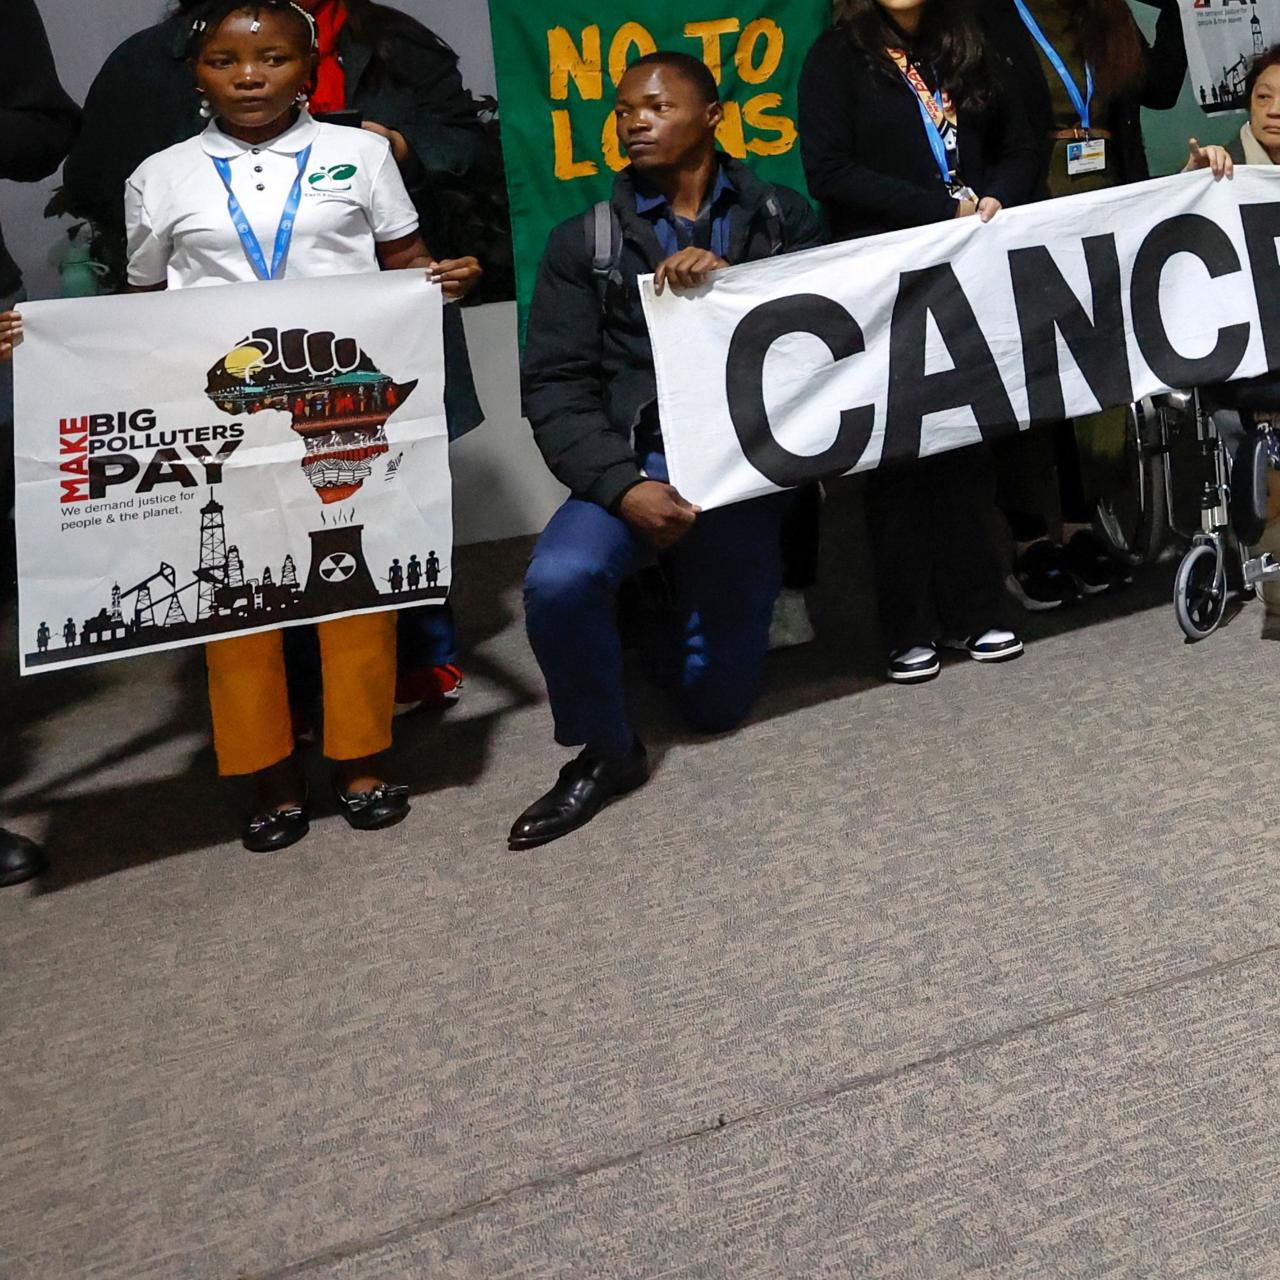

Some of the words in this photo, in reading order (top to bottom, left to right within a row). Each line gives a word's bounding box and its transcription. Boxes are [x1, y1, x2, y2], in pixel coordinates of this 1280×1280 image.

[683, 17, 784, 87] TO
[89, 409, 156, 436] BIG
[89, 423, 244, 454] POLLUTERS
[60, 416, 88, 503] MAKE
[88, 439, 243, 499] PAY
[61, 507, 81, 517] We
[84, 499, 134, 514] demand
[138, 492, 176, 508] justice
[180, 491, 195, 502] for
[61, 516, 102, 531] people
[106, 515, 116, 524] &
[119, 512, 139, 522] the
[143, 505, 183, 520] planet.
